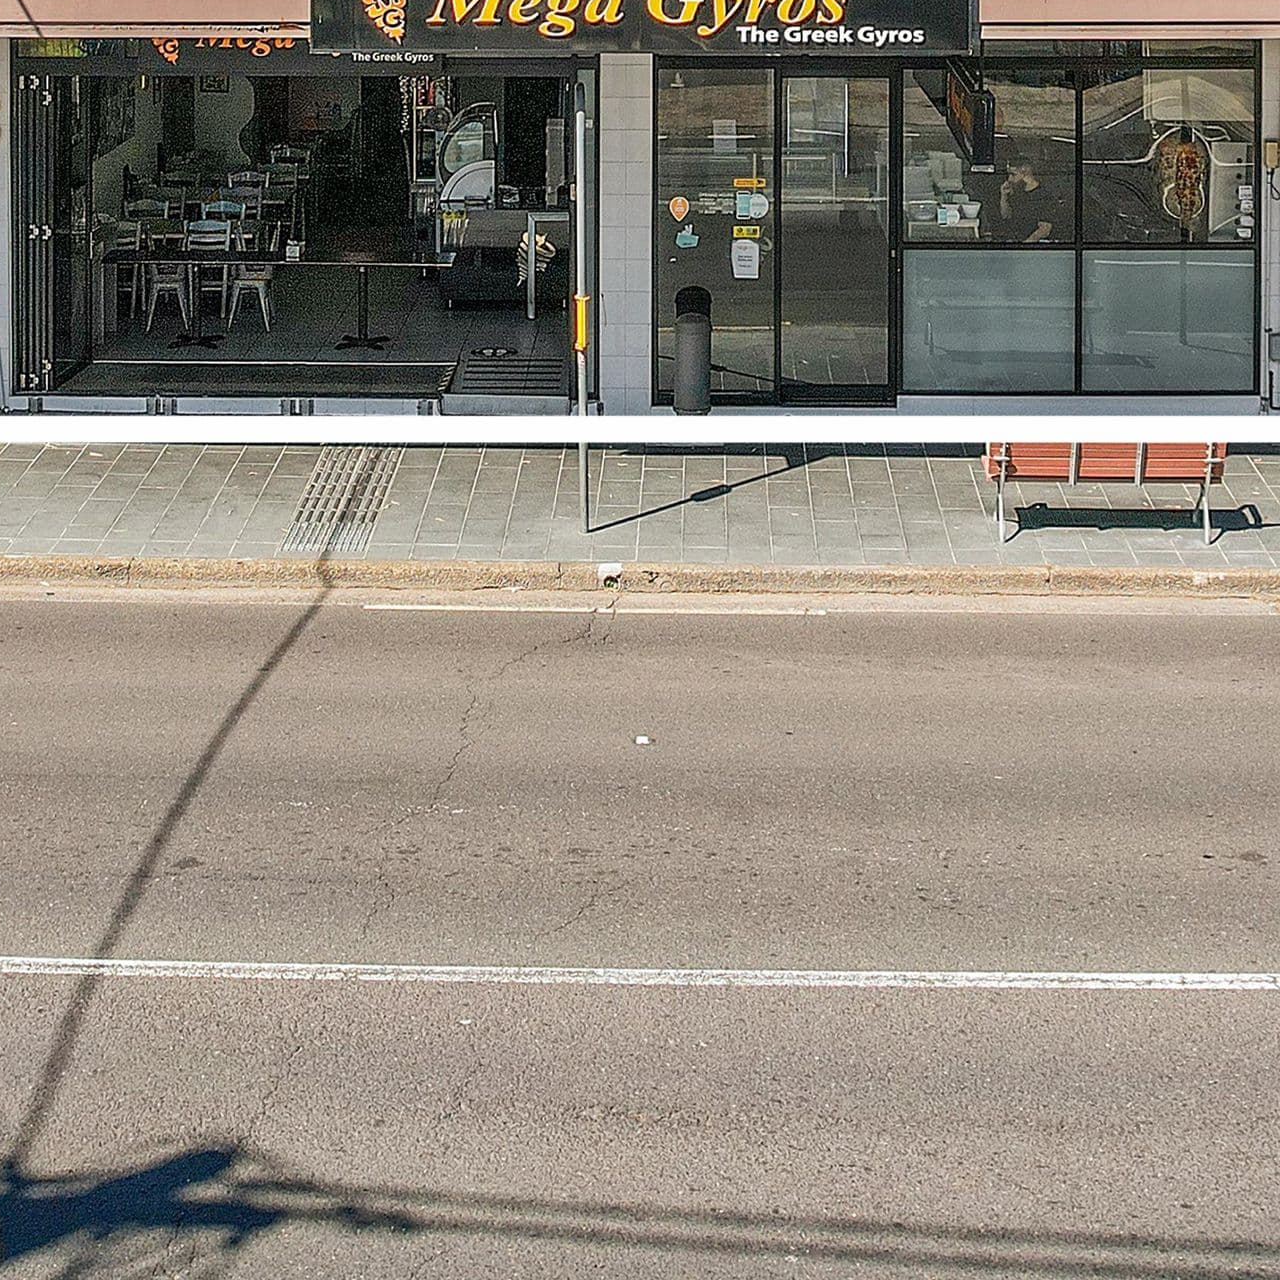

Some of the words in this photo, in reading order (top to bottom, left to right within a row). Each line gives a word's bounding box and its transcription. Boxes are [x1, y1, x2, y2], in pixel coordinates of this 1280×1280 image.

[736, 25, 779, 44] The
[783, 25, 855, 44] Greek
[856, 25, 926, 48] Gyros
[351, 52, 371, 63] The
[372, 52, 403, 63] Greek
[404, 52, 435, 65] Gyros
